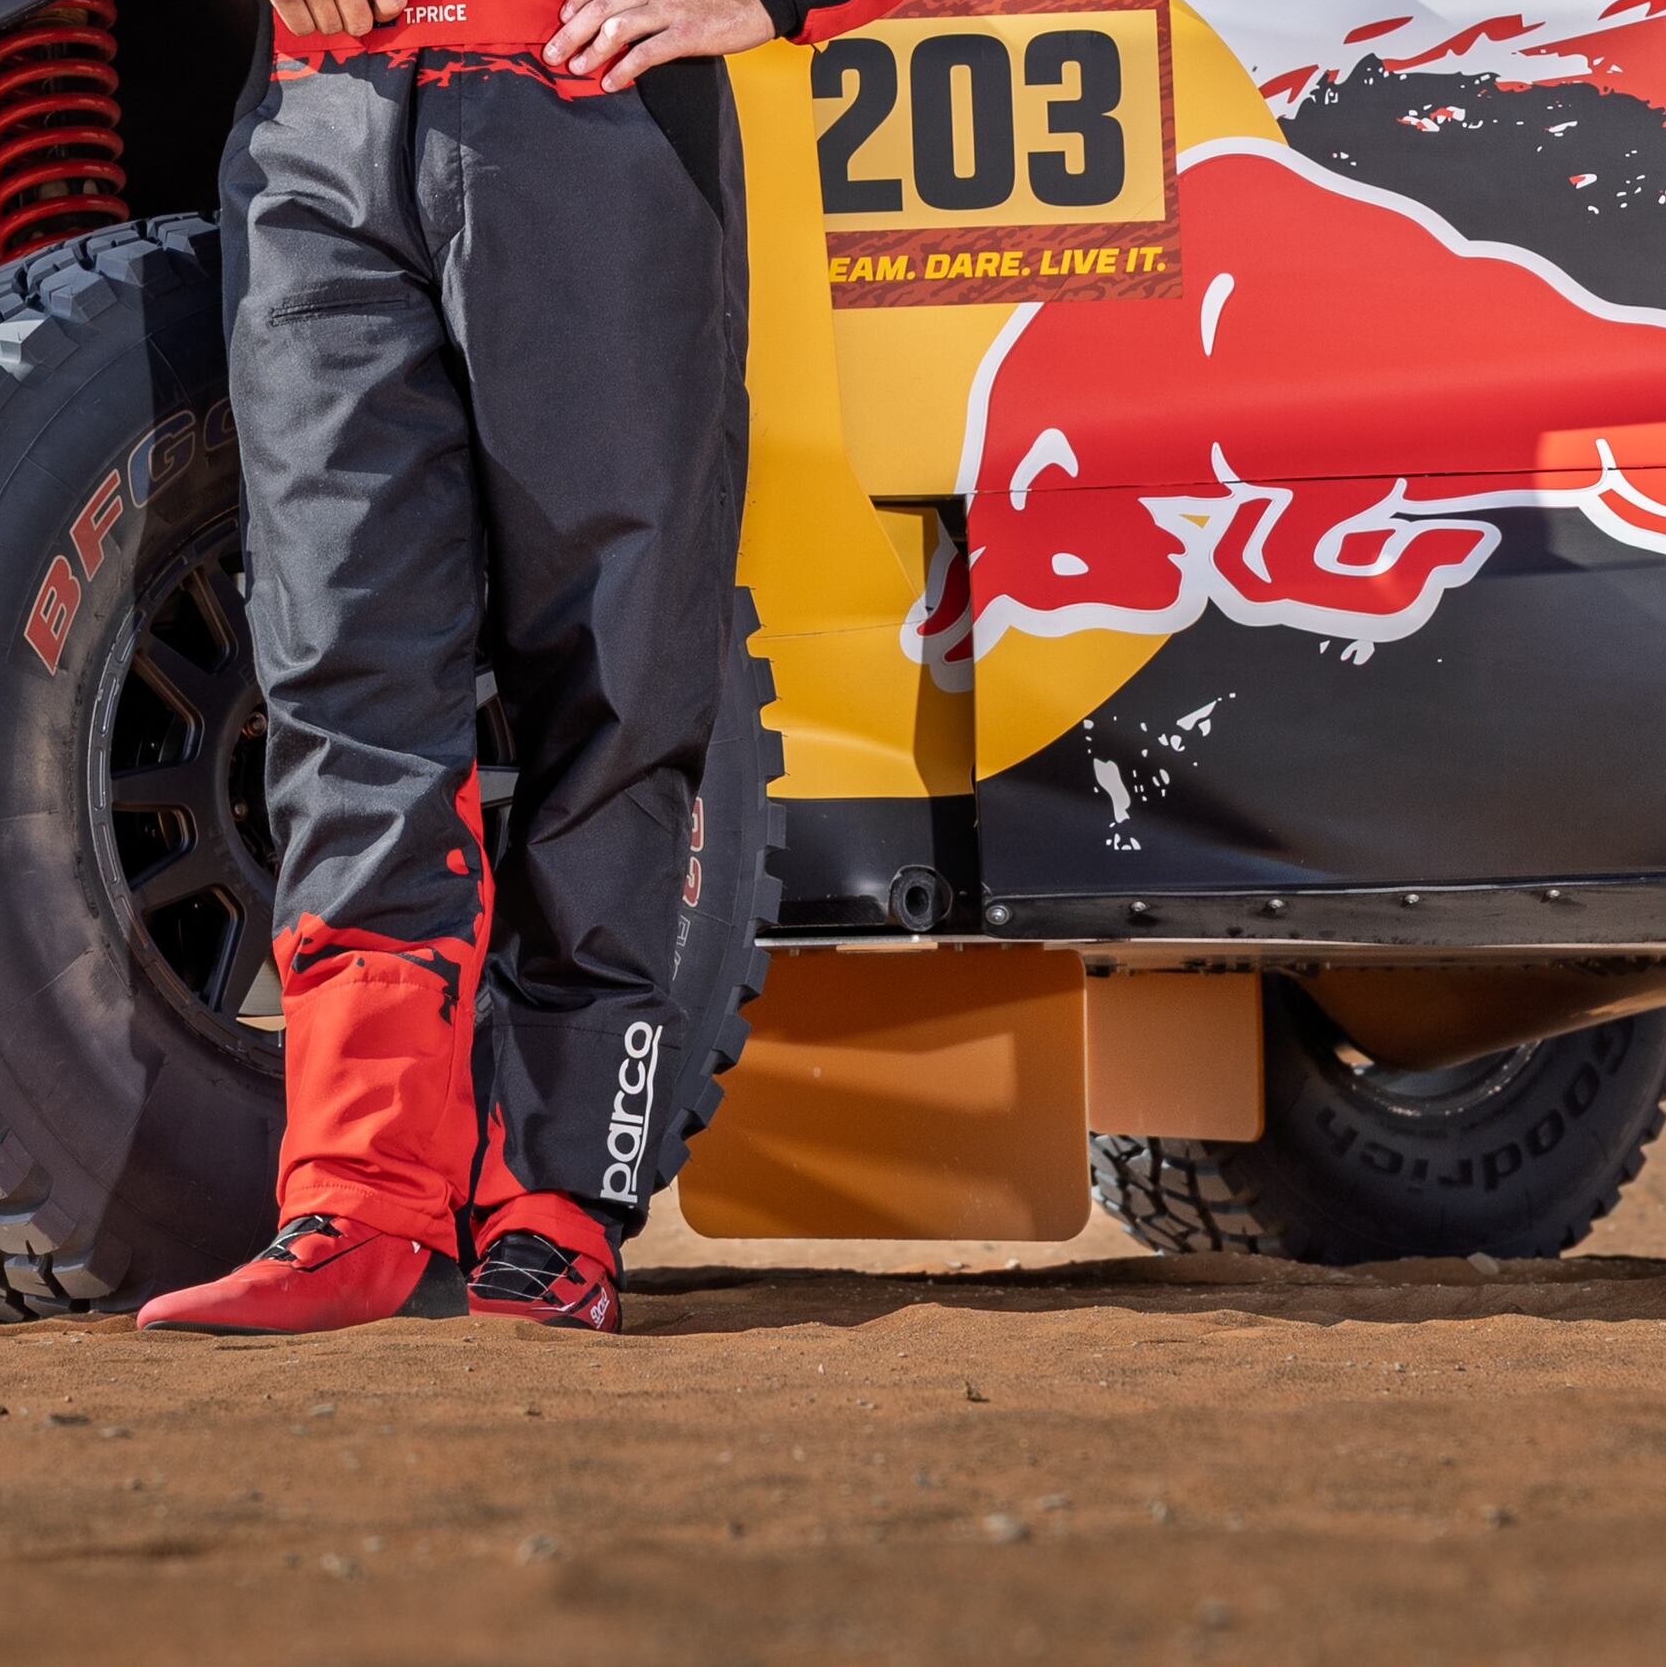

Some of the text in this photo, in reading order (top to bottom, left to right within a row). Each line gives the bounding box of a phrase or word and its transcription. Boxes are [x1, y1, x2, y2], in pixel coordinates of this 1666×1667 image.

[404, 4, 467, 24] T.PRICE
[810, 29, 1126, 215] 203
[924, 252, 1031, 279] DARE.
[1040, 249, 1120, 277] LIVE
[1126, 246, 1166, 272] IT.
